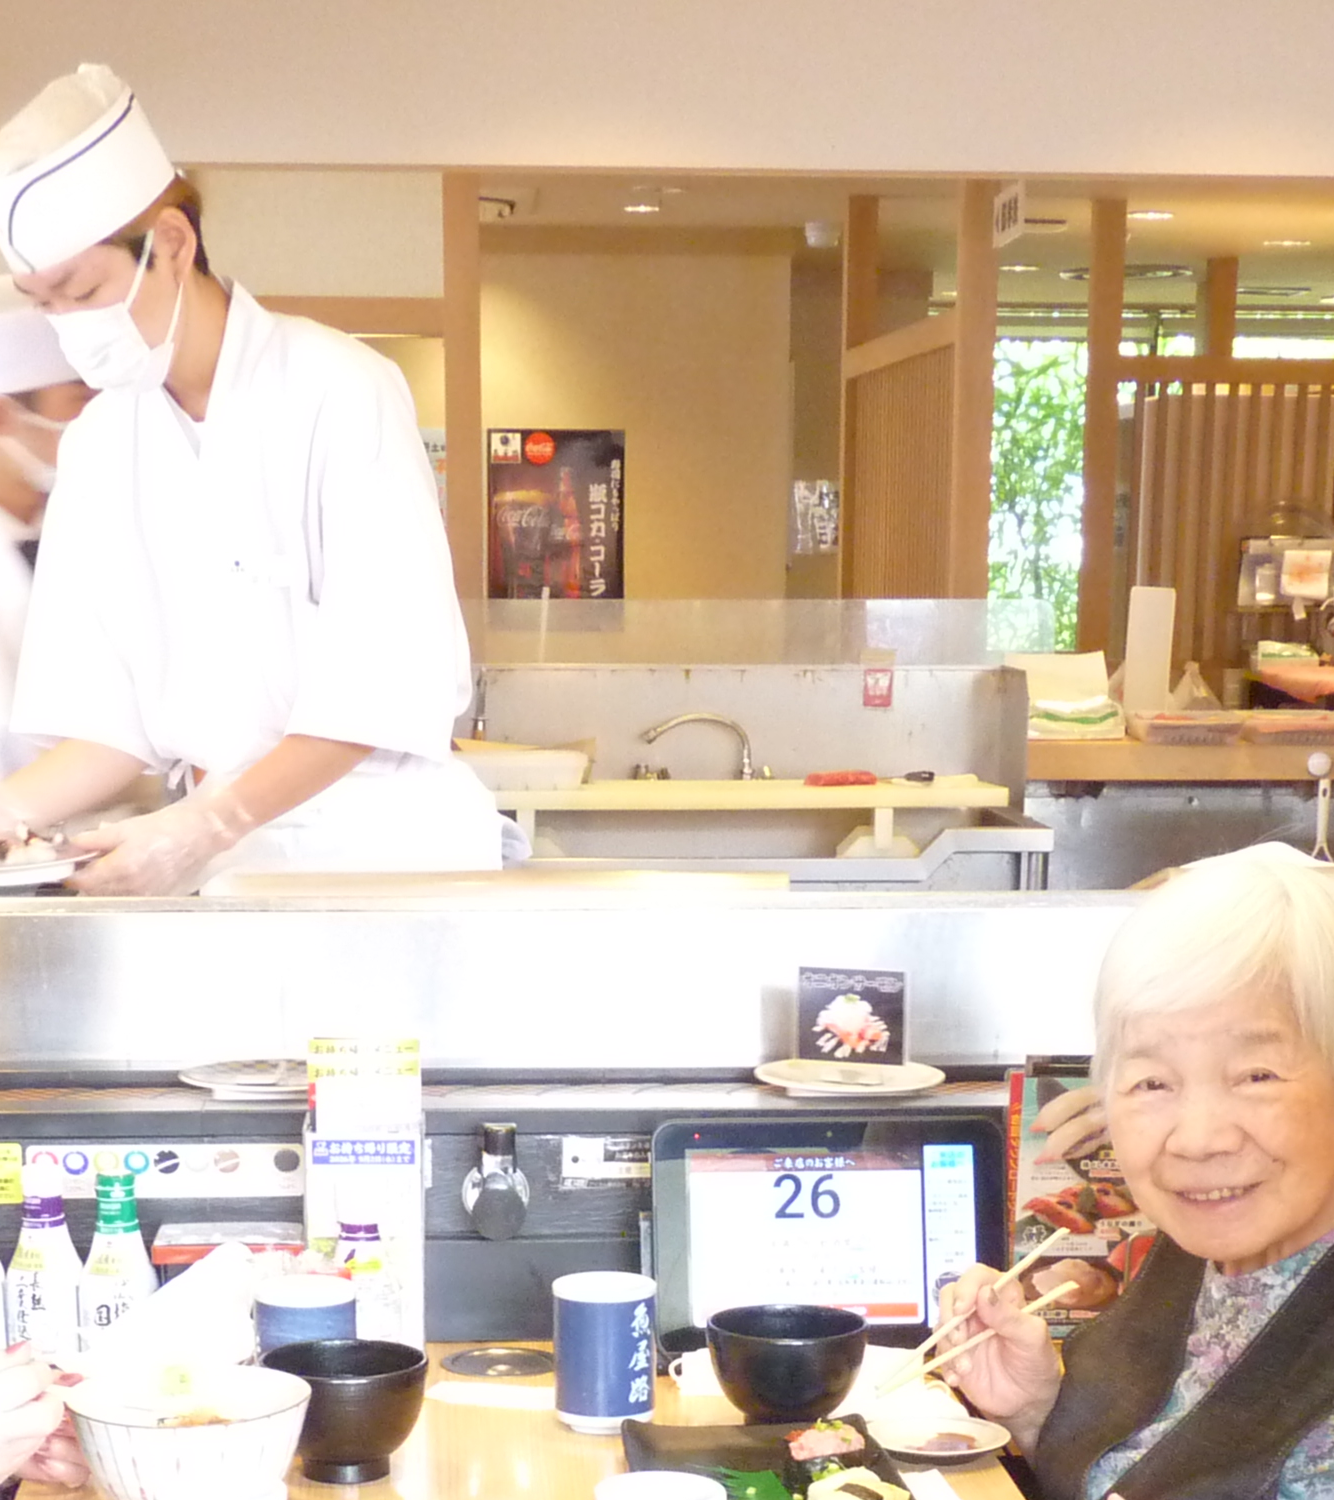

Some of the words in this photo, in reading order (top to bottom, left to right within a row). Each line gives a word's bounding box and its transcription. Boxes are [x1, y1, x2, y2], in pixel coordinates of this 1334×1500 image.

[772, 1173, 842, 1220] 26
[628, 1302, 650, 1403] 魚屋路
